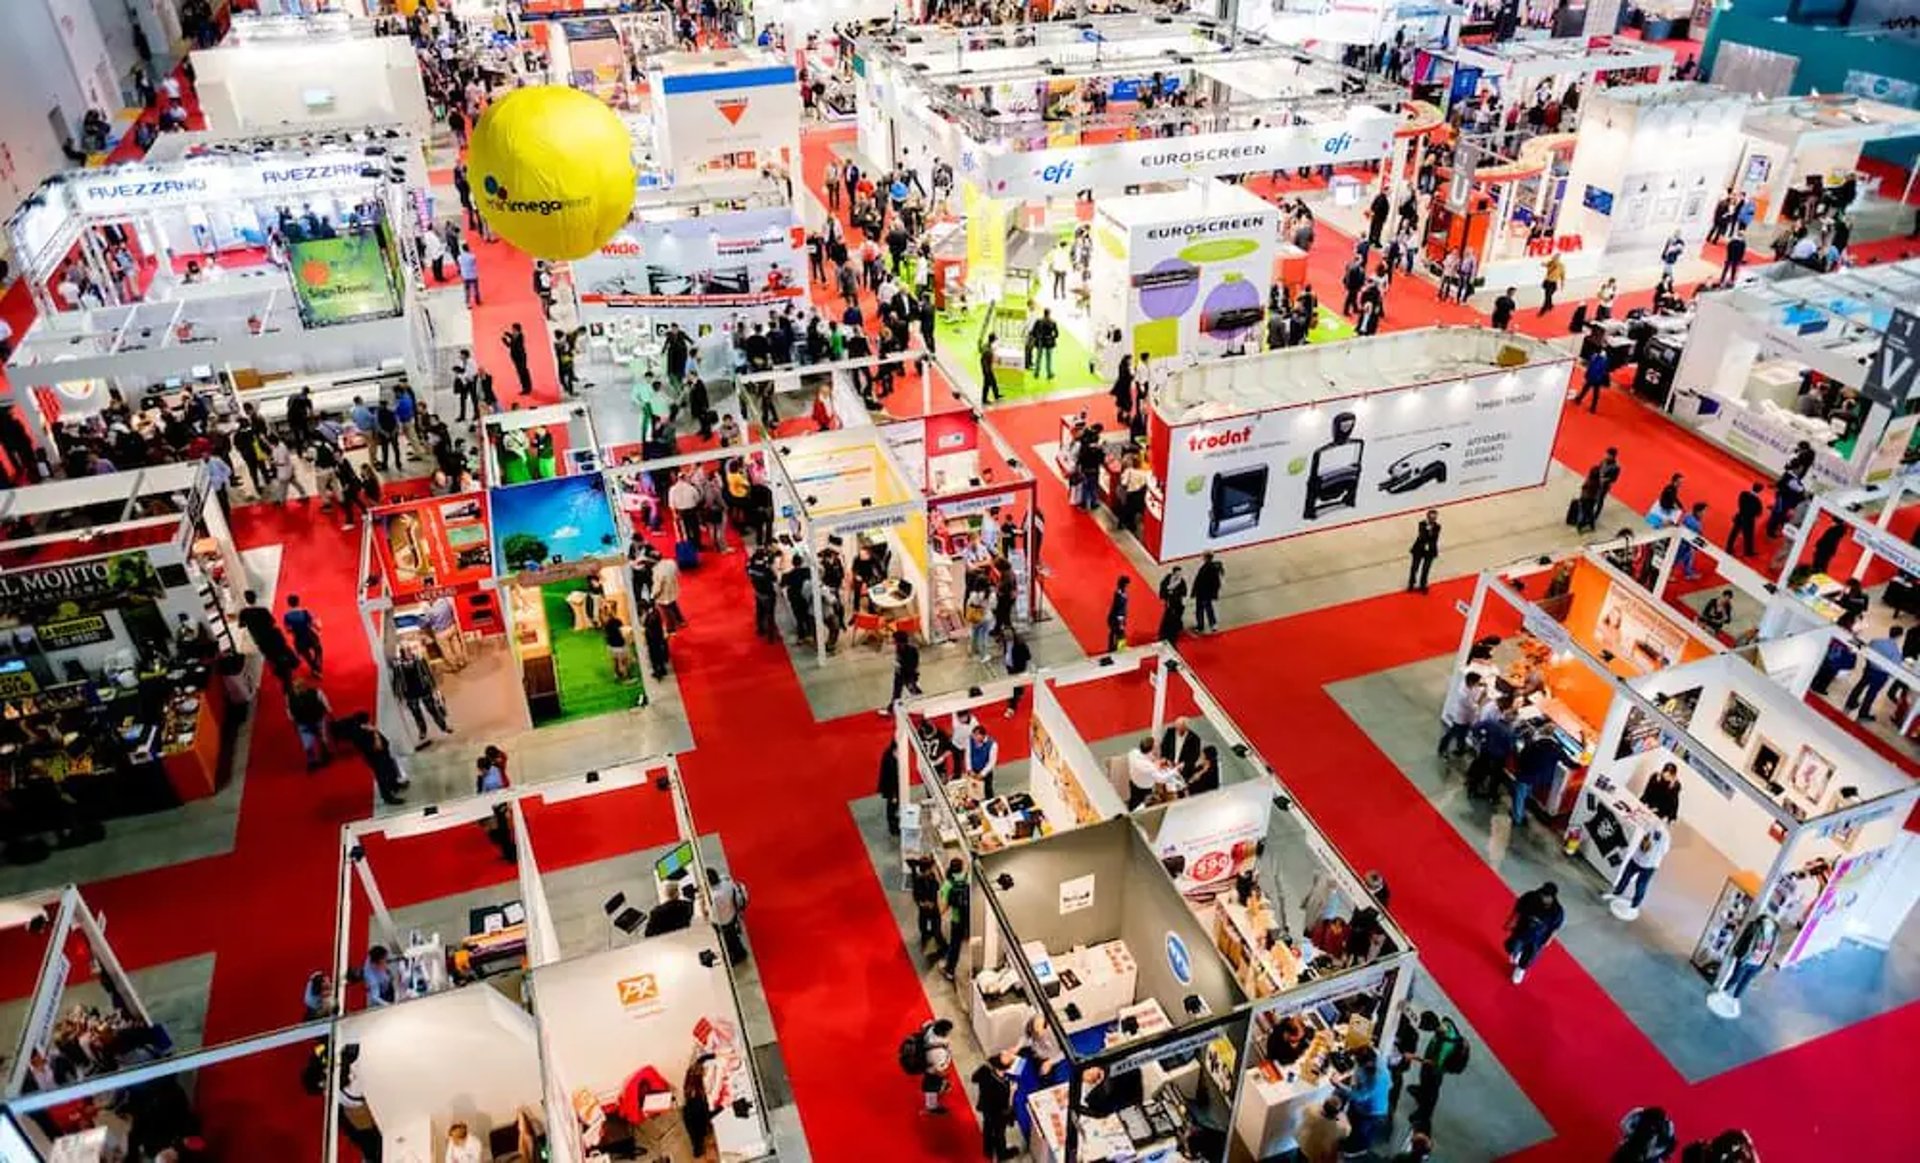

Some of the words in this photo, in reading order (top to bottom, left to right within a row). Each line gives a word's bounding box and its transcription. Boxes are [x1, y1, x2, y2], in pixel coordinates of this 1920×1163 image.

[1324, 131, 1352, 155] efi
[1141, 144, 1266, 168] EUROSCREEN
[1042, 158, 1075, 183] efi
[1147, 216, 1265, 239] EUROSCREEN
[1904, 320, 1915, 337] 1
[1881, 346, 1914, 390] V
[1188, 426, 1253, 451] trodat
[19, 561, 109, 593] MOJITO
